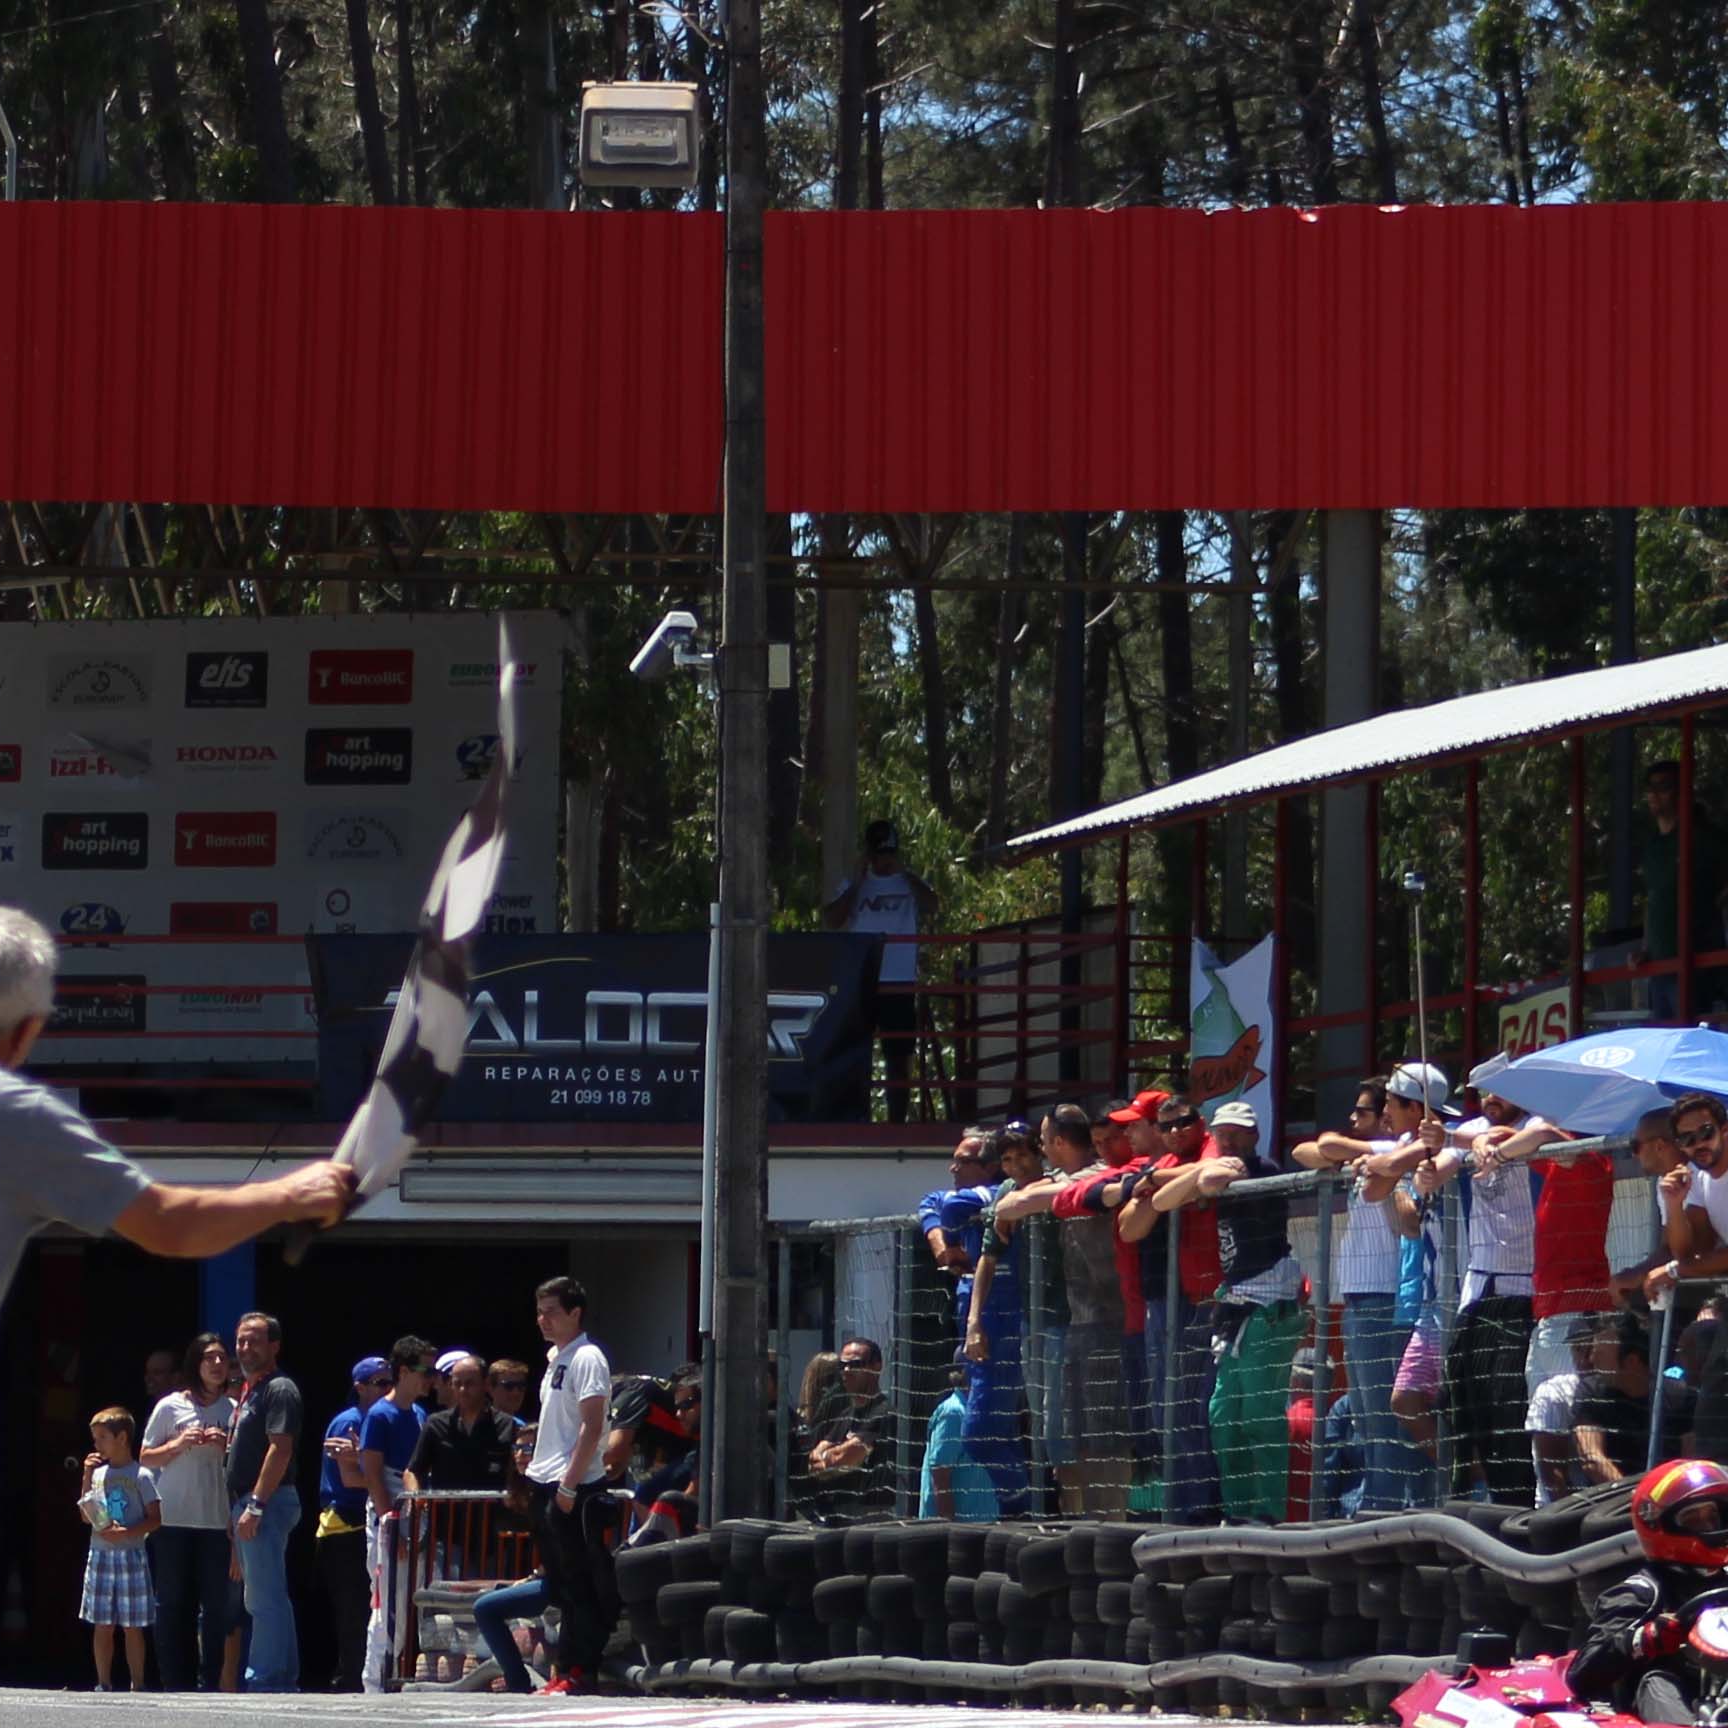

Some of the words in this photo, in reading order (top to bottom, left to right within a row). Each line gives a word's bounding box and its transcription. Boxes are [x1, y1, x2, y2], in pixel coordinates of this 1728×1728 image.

[449, 663, 537, 676] EURODY
[341, 672, 407, 686] BancoBIC
[176, 745, 278, 762] HONDA
[205, 833, 268, 847] BancoBIC
[70, 907, 109, 931] 24
[1500, 1002, 1568, 1056] GAS
[485, 1065, 642, 1085] REPARAÇÕES
[657, 1068, 702, 1083] AUT
[551, 1089, 570, 1104] 21
[575, 1089, 603, 1104] 099
[608, 1090, 626, 1105] 18
[632, 1090, 651, 1105] 78
